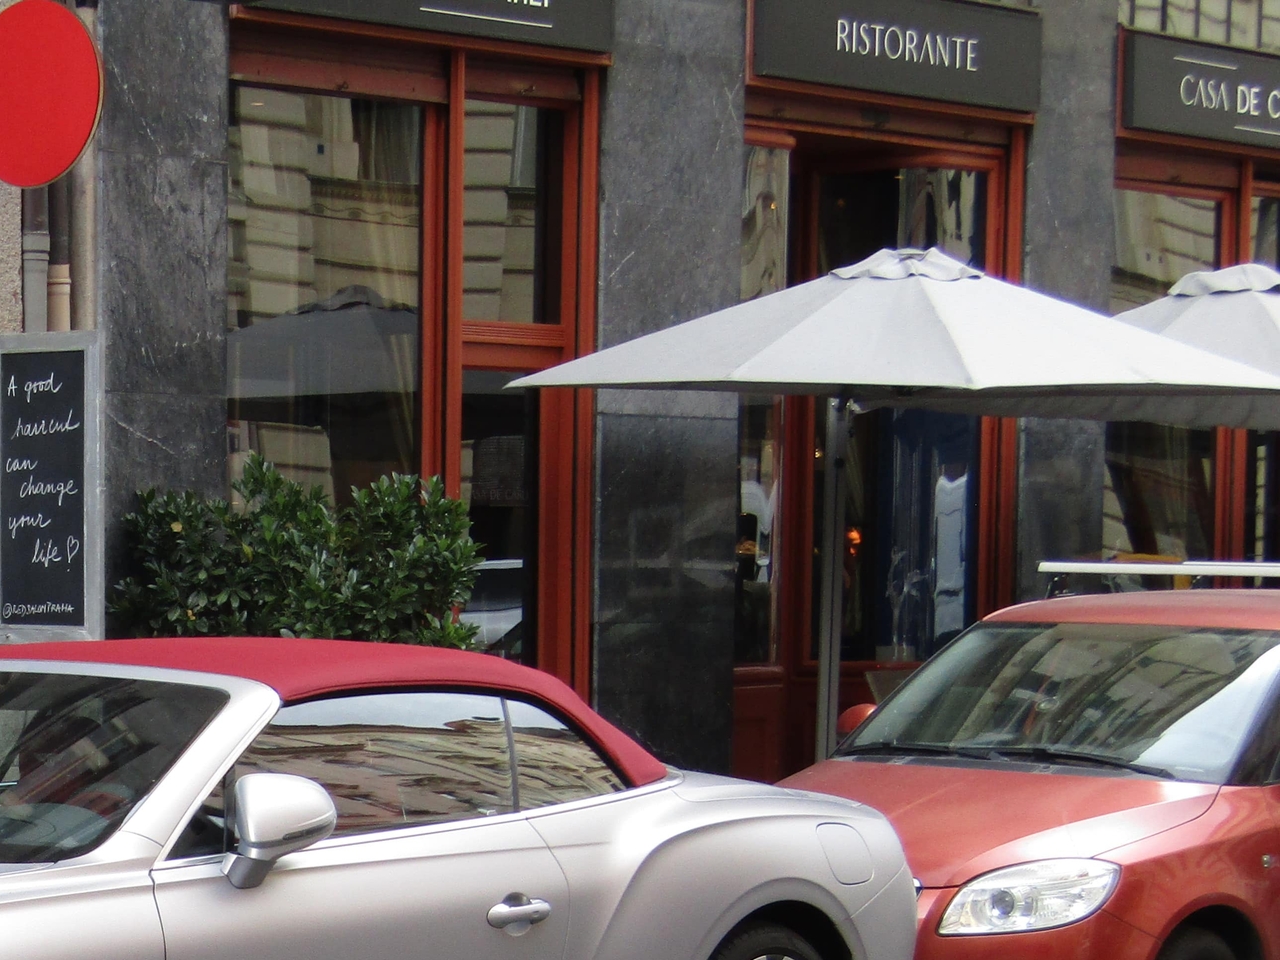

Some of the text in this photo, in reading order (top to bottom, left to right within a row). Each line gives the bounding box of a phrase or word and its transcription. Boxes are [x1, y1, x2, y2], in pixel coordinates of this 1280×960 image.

[836, 19, 978, 72] RISTORANTE
[1180, 74, 1228, 111] CASA
[1236, 85, 1260, 116] DE
[7, 372, 63, 403] A good
[10, 409, 80, 440] haircut
[6, 458, 38, 473] can
[20, 475, 78, 506] change
[8, 513, 51, 539] your
[31, 538, 62, 568] life
